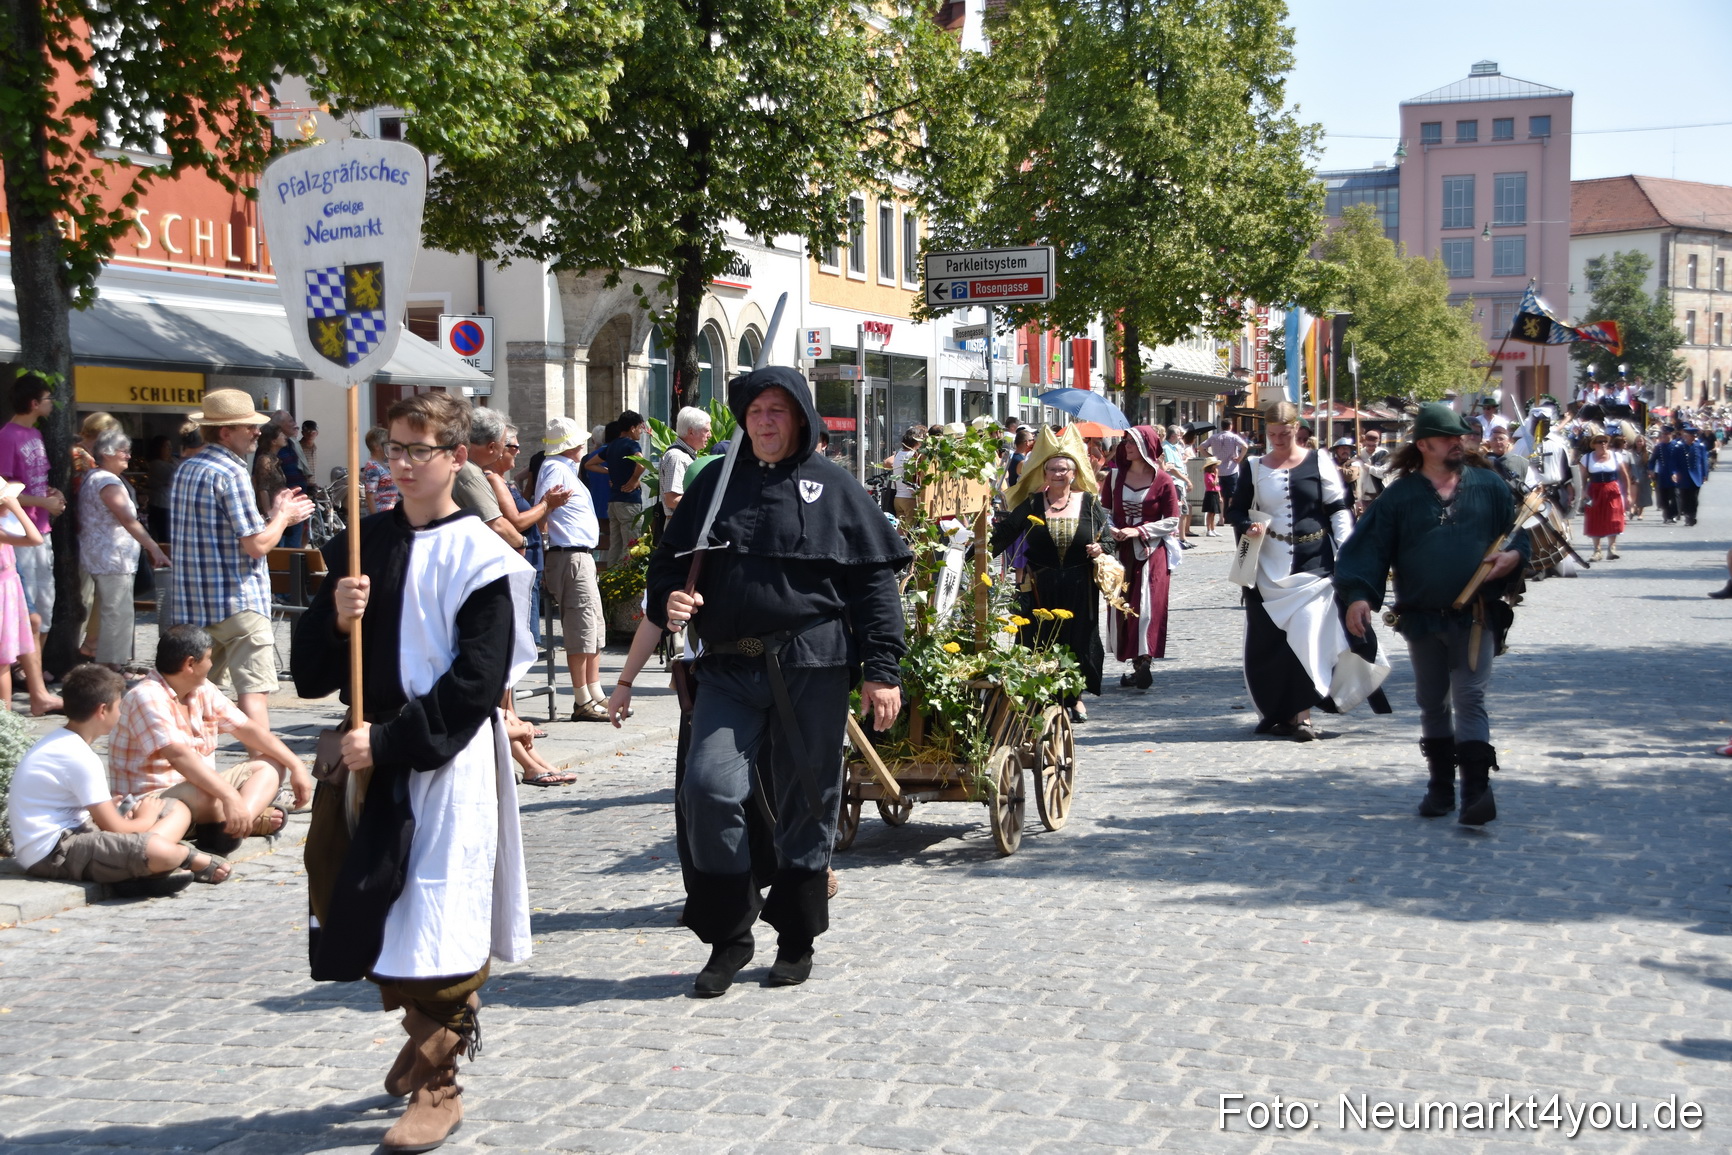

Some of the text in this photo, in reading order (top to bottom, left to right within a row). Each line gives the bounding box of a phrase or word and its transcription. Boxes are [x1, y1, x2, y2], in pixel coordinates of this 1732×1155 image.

[277, 157, 411, 205] Pfalzgräfisches
[322, 200, 364, 218] Gefolge
[303, 217, 385, 246] Neumarkt
[946, 257, 1027, 273] Parkleitsystem
[975, 282, 1029, 295] Rosengasse
[955, 328, 984, 339] Rosengasse
